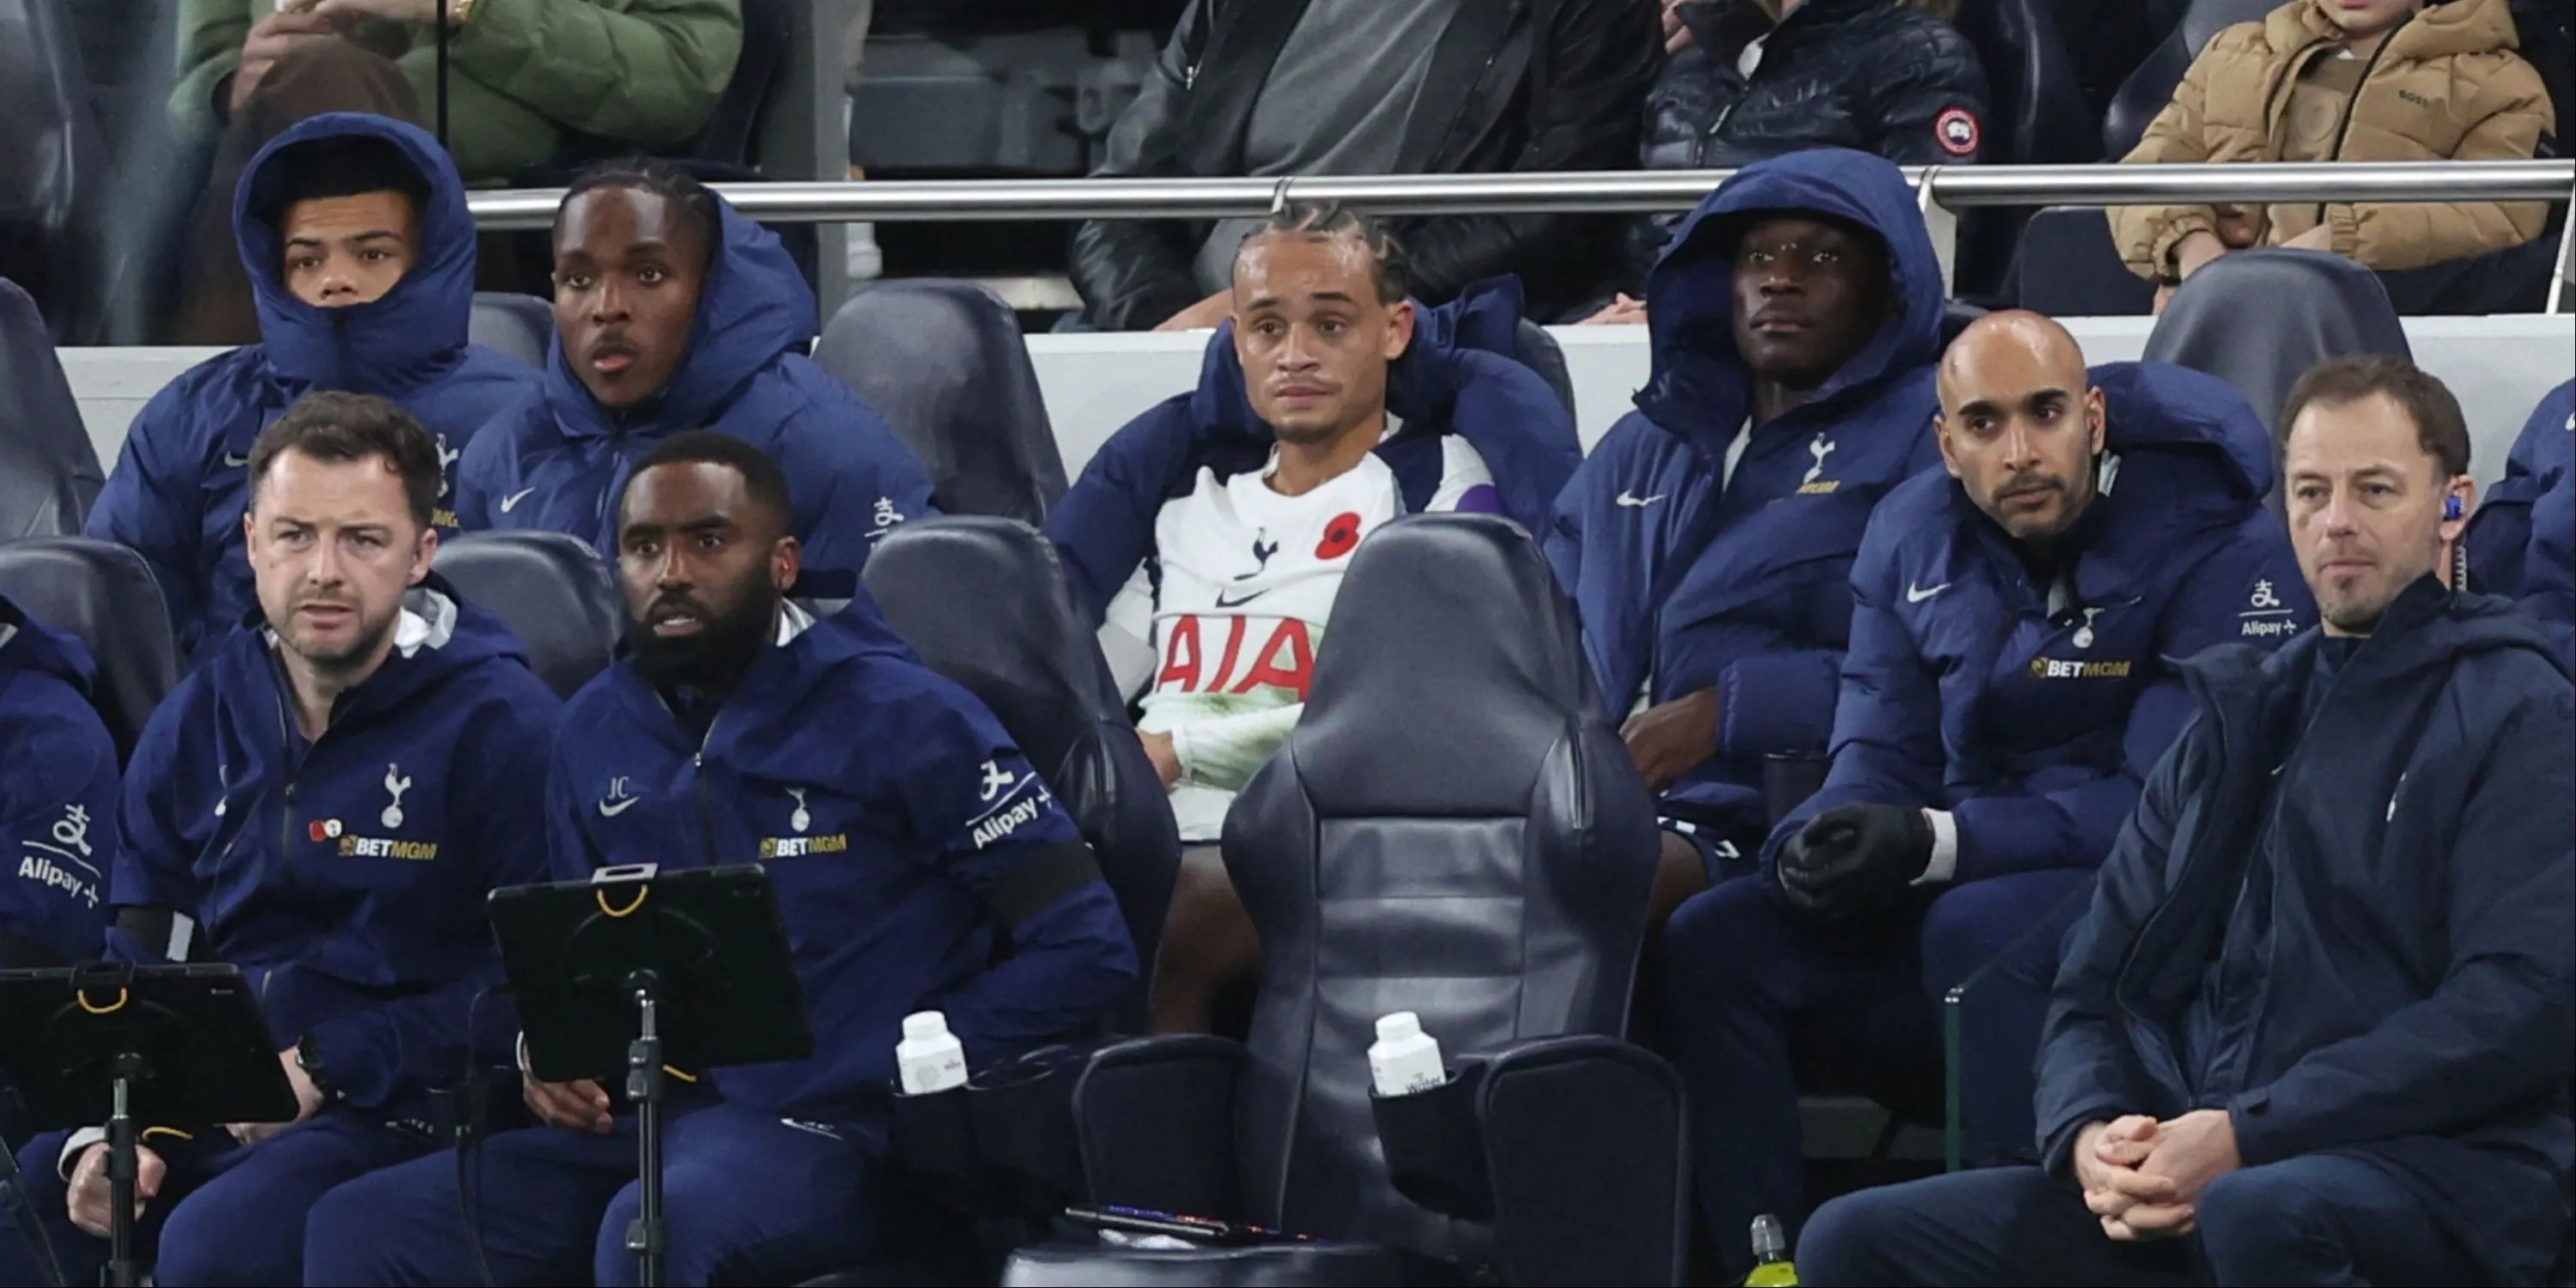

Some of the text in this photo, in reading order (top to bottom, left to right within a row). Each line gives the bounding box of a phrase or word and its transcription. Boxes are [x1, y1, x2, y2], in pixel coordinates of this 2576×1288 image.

[1155, 613, 1314, 703] AIA
[607, 776, 629, 799] JC
[355, 837, 438, 860] BETMGM
